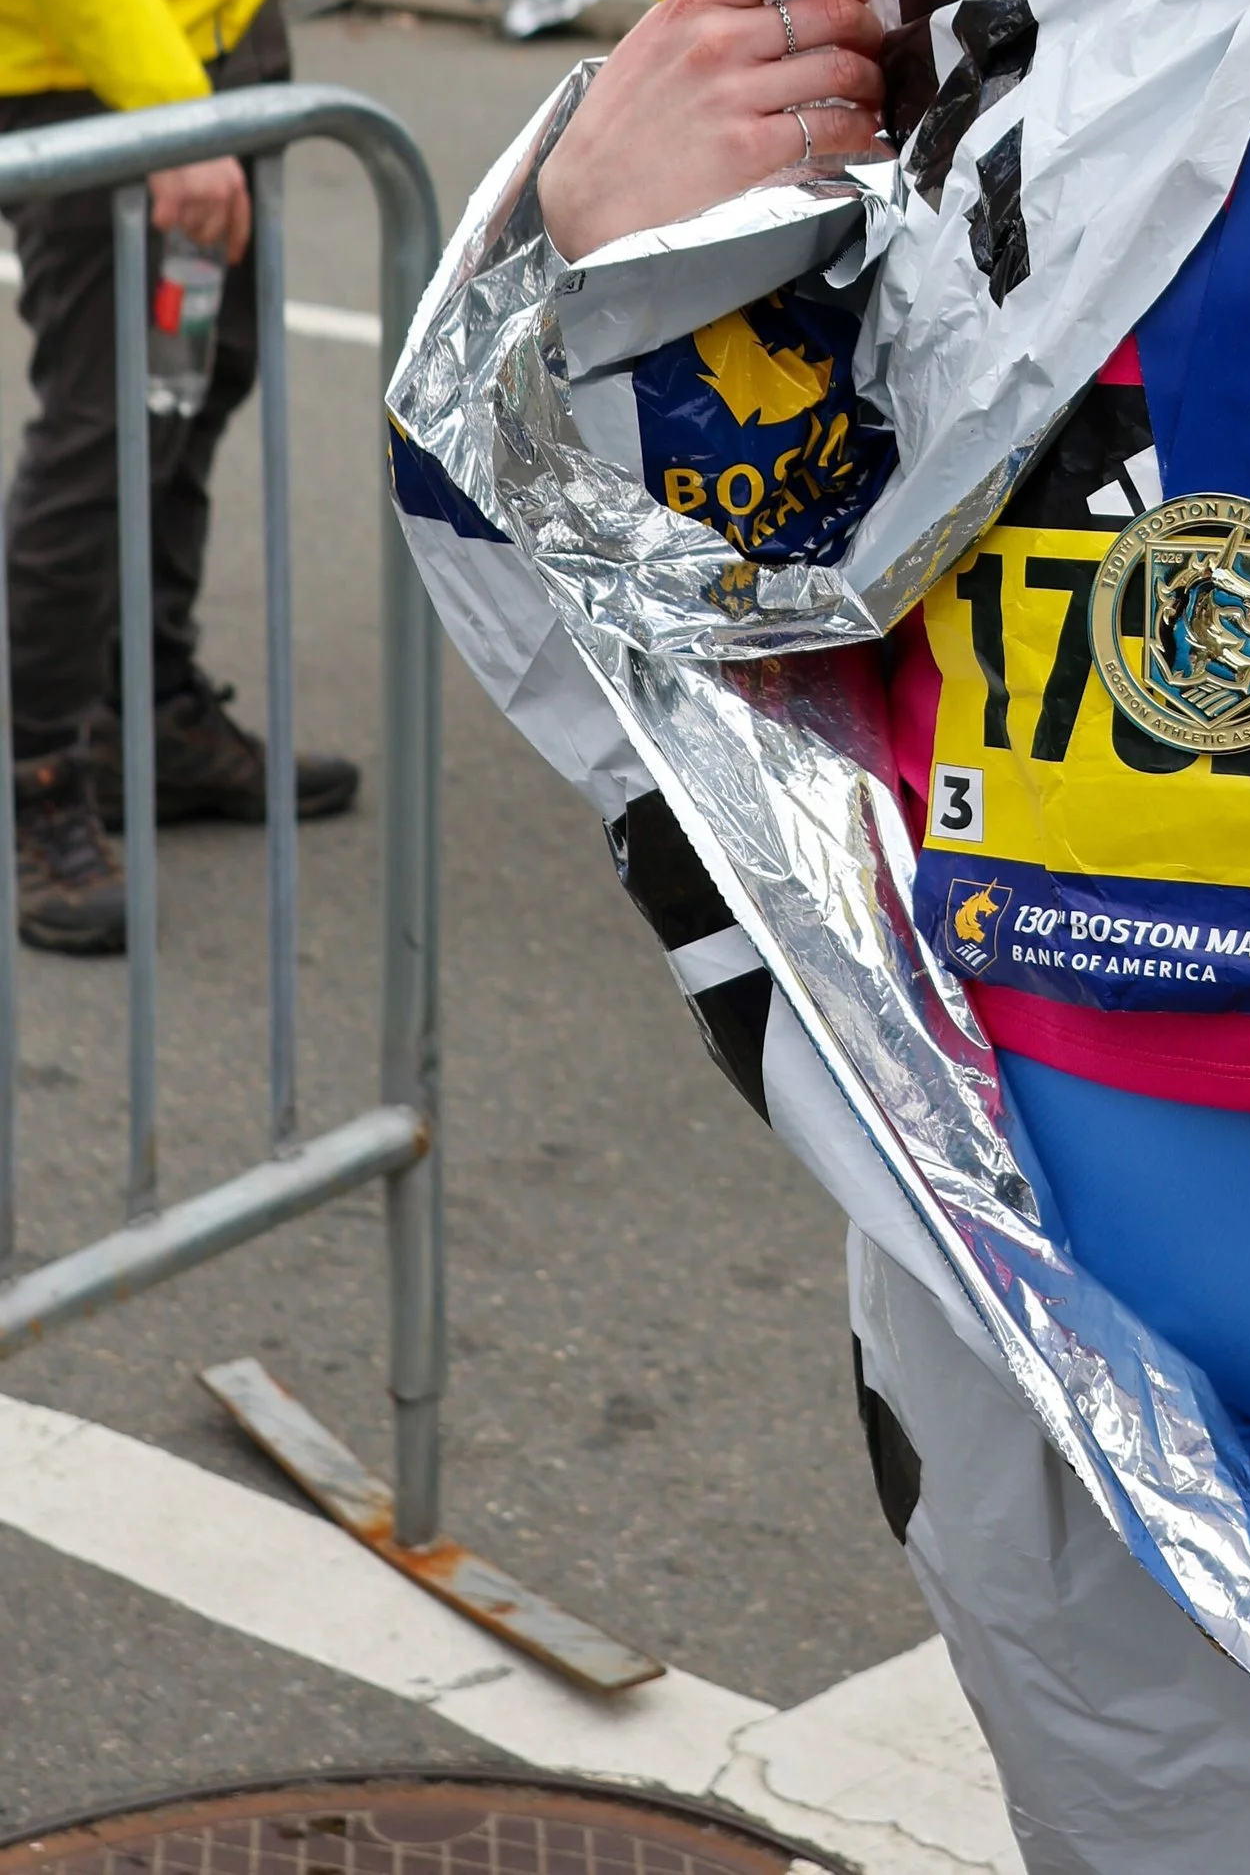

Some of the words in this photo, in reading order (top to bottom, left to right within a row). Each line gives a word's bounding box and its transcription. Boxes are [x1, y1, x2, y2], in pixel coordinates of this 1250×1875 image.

[1101, 538, 1134, 589] 130TH
[1134, 501, 1219, 541] BOSTON
[1154, 552, 1184, 564] 2026
[1105, 661, 1149, 718] BOSTON
[1152, 718, 1225, 744] ATHLETIC
[939, 776, 972, 831] 3
[1070, 911, 1198, 950] BOSTON
[1012, 945, 1065, 968] BANK
[1071, 953, 1102, 971] OF
[1106, 956, 1216, 983] AMERICA
